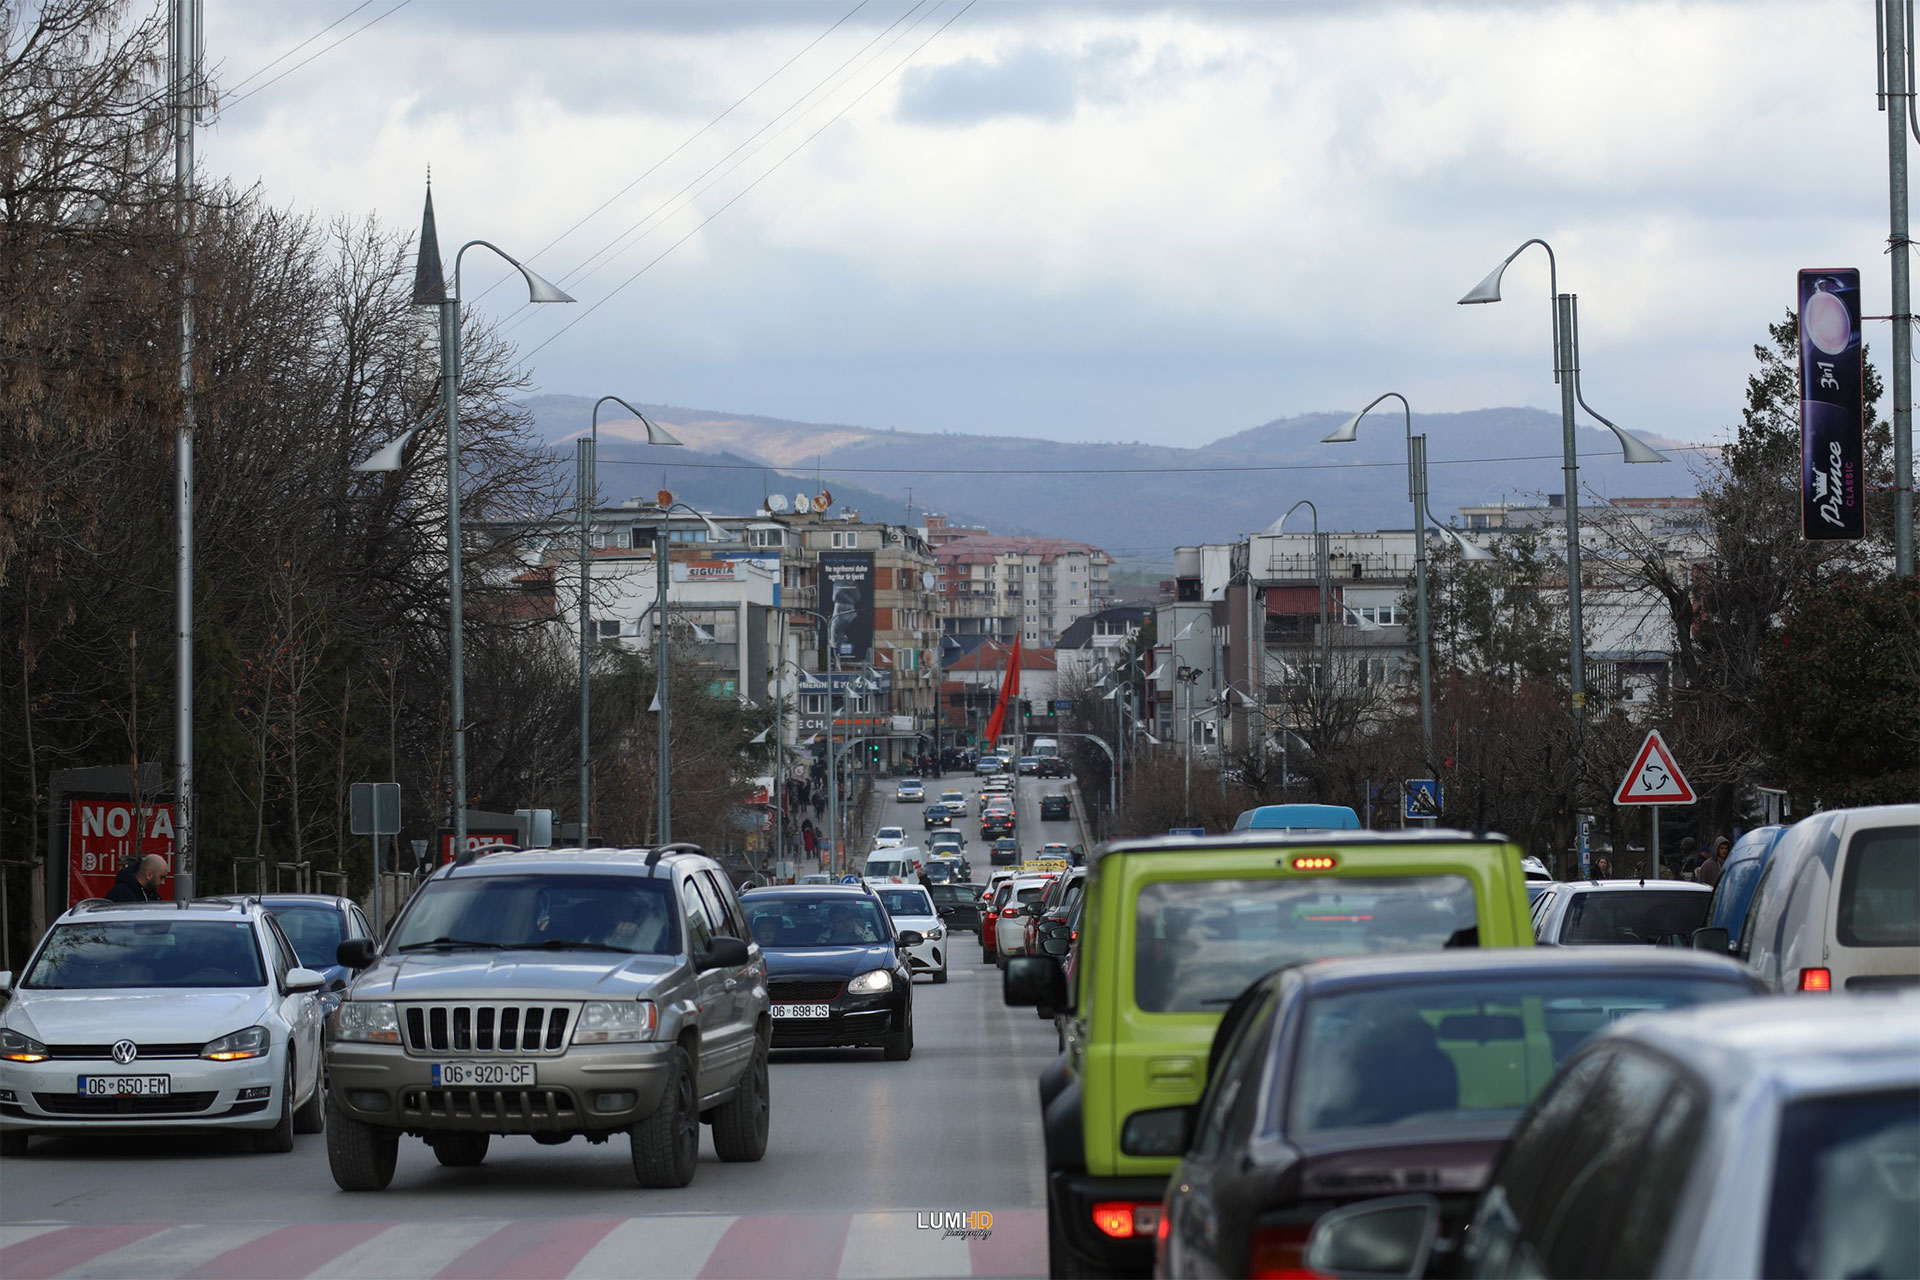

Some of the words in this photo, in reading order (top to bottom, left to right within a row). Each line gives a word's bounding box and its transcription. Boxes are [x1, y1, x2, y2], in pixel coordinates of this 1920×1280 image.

[1817, 361, 1839, 391] 3in1
[1820, 440, 1845, 528] Prince
[1846, 461, 1854, 507] CLASSIC
[689, 567, 734, 576] SIGURIA
[82, 806, 175, 839] NOTA
[772, 1006, 785, 1017] 06
[89, 1078, 106, 1094] 06
[444, 1066, 463, 1083] 06
